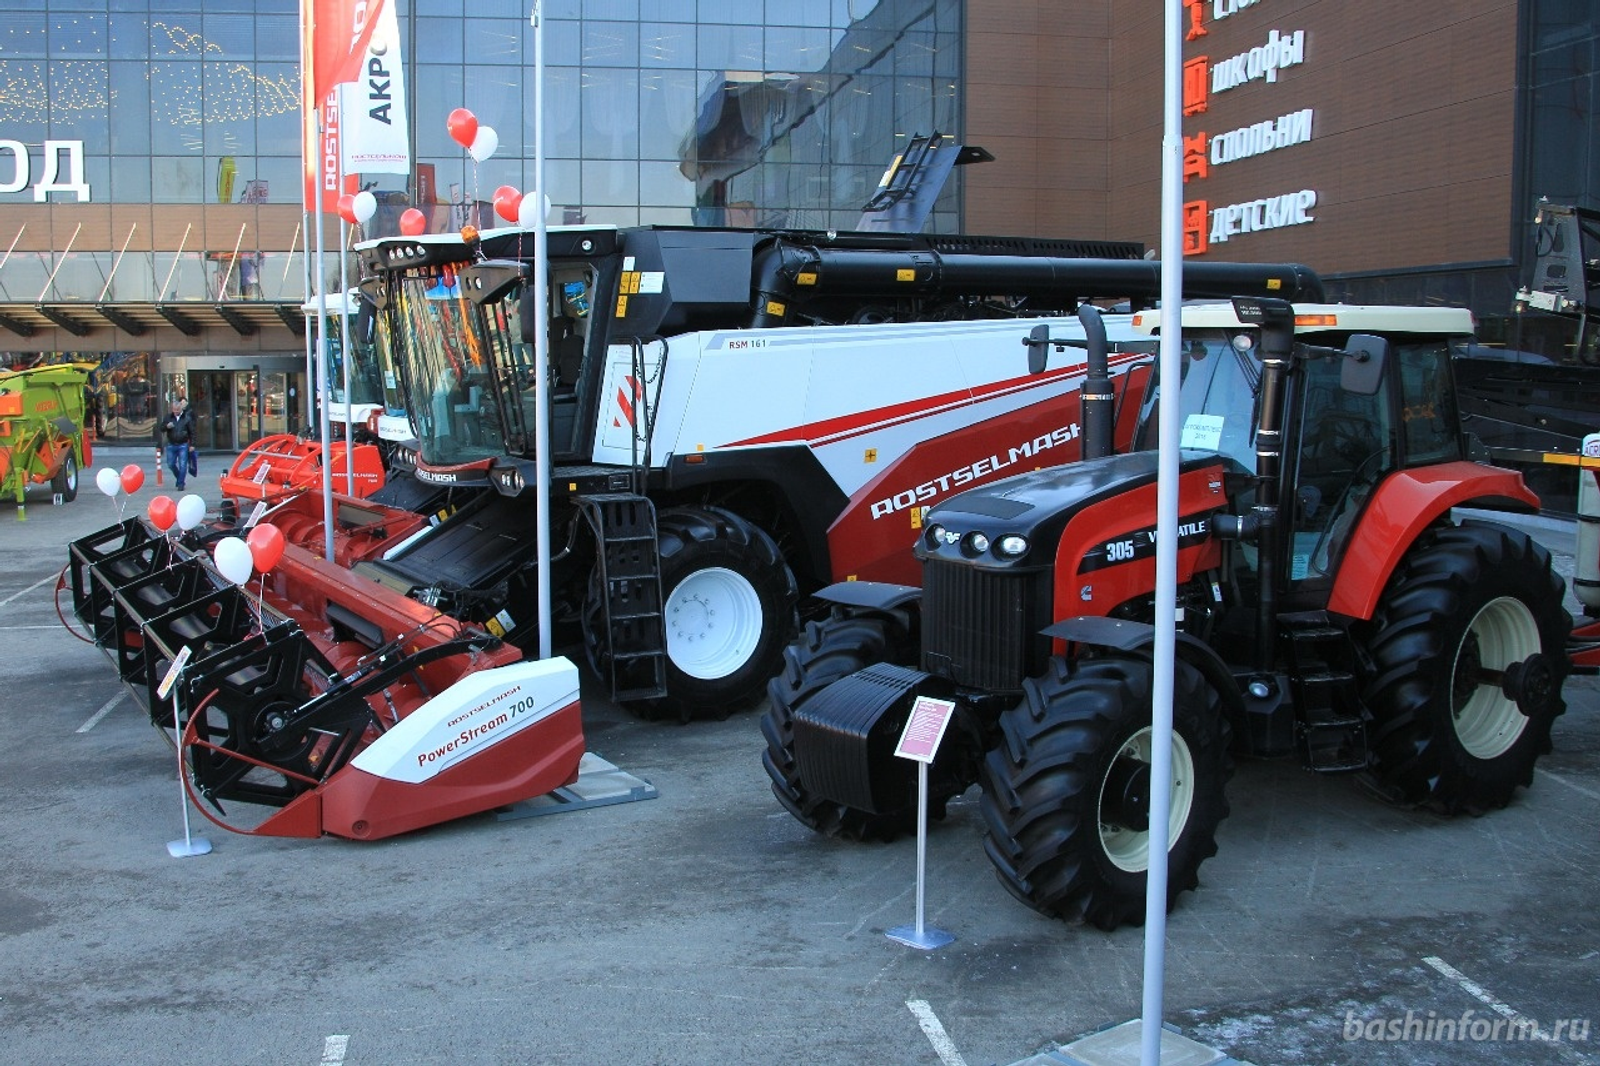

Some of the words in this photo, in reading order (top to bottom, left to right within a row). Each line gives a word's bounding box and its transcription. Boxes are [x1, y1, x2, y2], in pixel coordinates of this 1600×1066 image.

[1212, 30, 1305, 93] шкафы
[1211, 109, 1313, 165] спальни
[1210, 189, 1316, 243] детские
[729, 341, 748, 350] RSM
[750, 339, 766, 348] 161
[1106, 540, 1135, 562] 305
[1148, 520, 1206, 543] VATILE
[417, 713, 508, 767] PowerStream
[509, 696, 535, 718] 700
[447, 685, 522, 728] ROSTSELMASH
